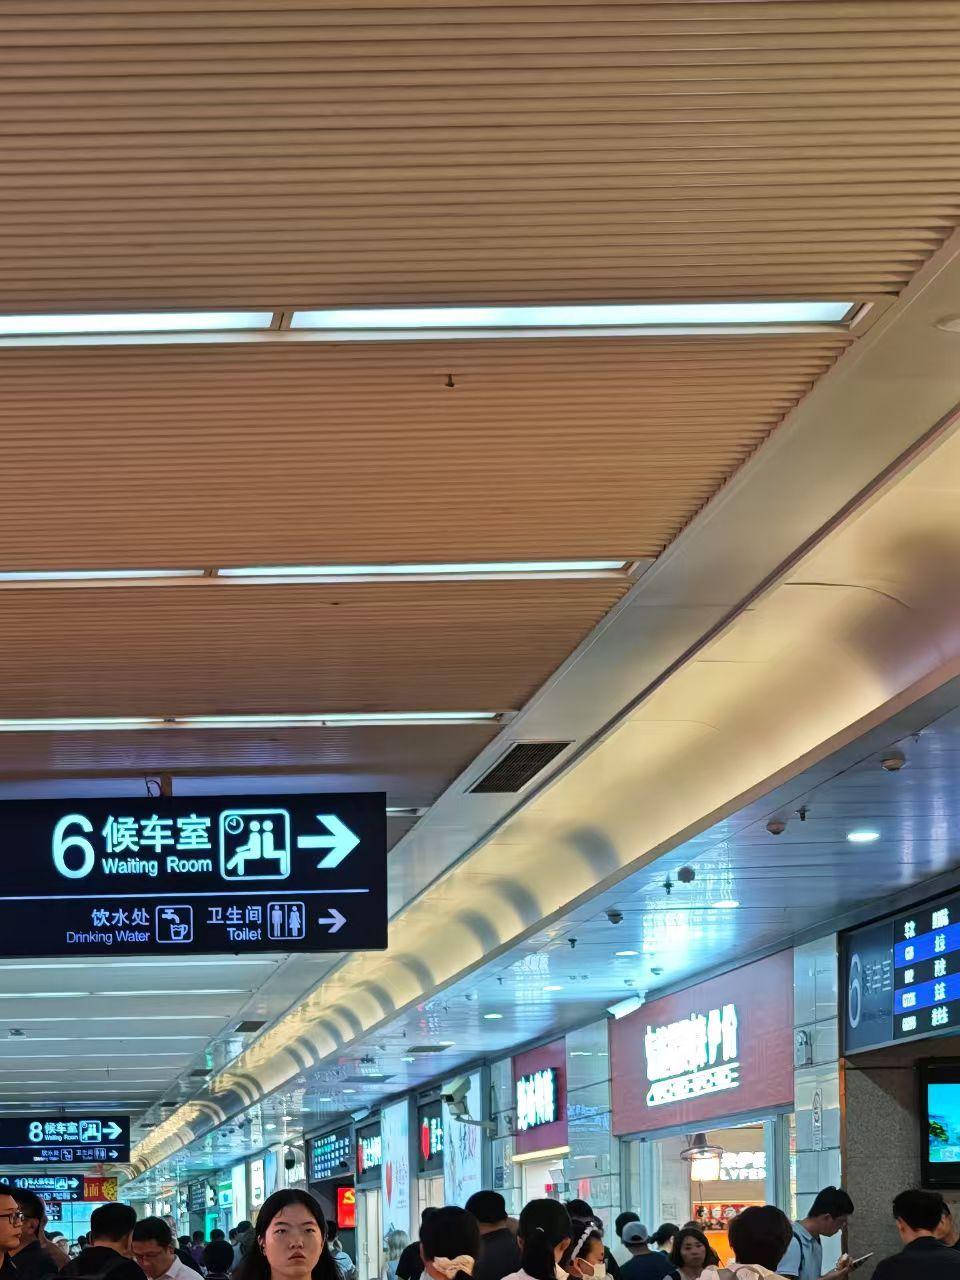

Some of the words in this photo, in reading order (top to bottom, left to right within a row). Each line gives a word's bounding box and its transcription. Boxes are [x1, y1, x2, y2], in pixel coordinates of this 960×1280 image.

[51, 813, 95, 879] 6
[101, 813, 212, 854] 候车室
[101, 857, 158, 876] Waiting
[166, 855, 213, 873] Room
[90, 907, 150, 927] 饮水处
[206, 905, 262, 925] 卫生间
[66, 931, 113, 945] Drinking
[120, 929, 151, 943] Water
[226, 927, 262, 941] Toilet
[848, 953, 861, 1029] 6
[28, 1121, 44, 1142] 8
[44, 1122, 79, 1135] 候车室
[44, 1134, 63, 1142] Waiting
